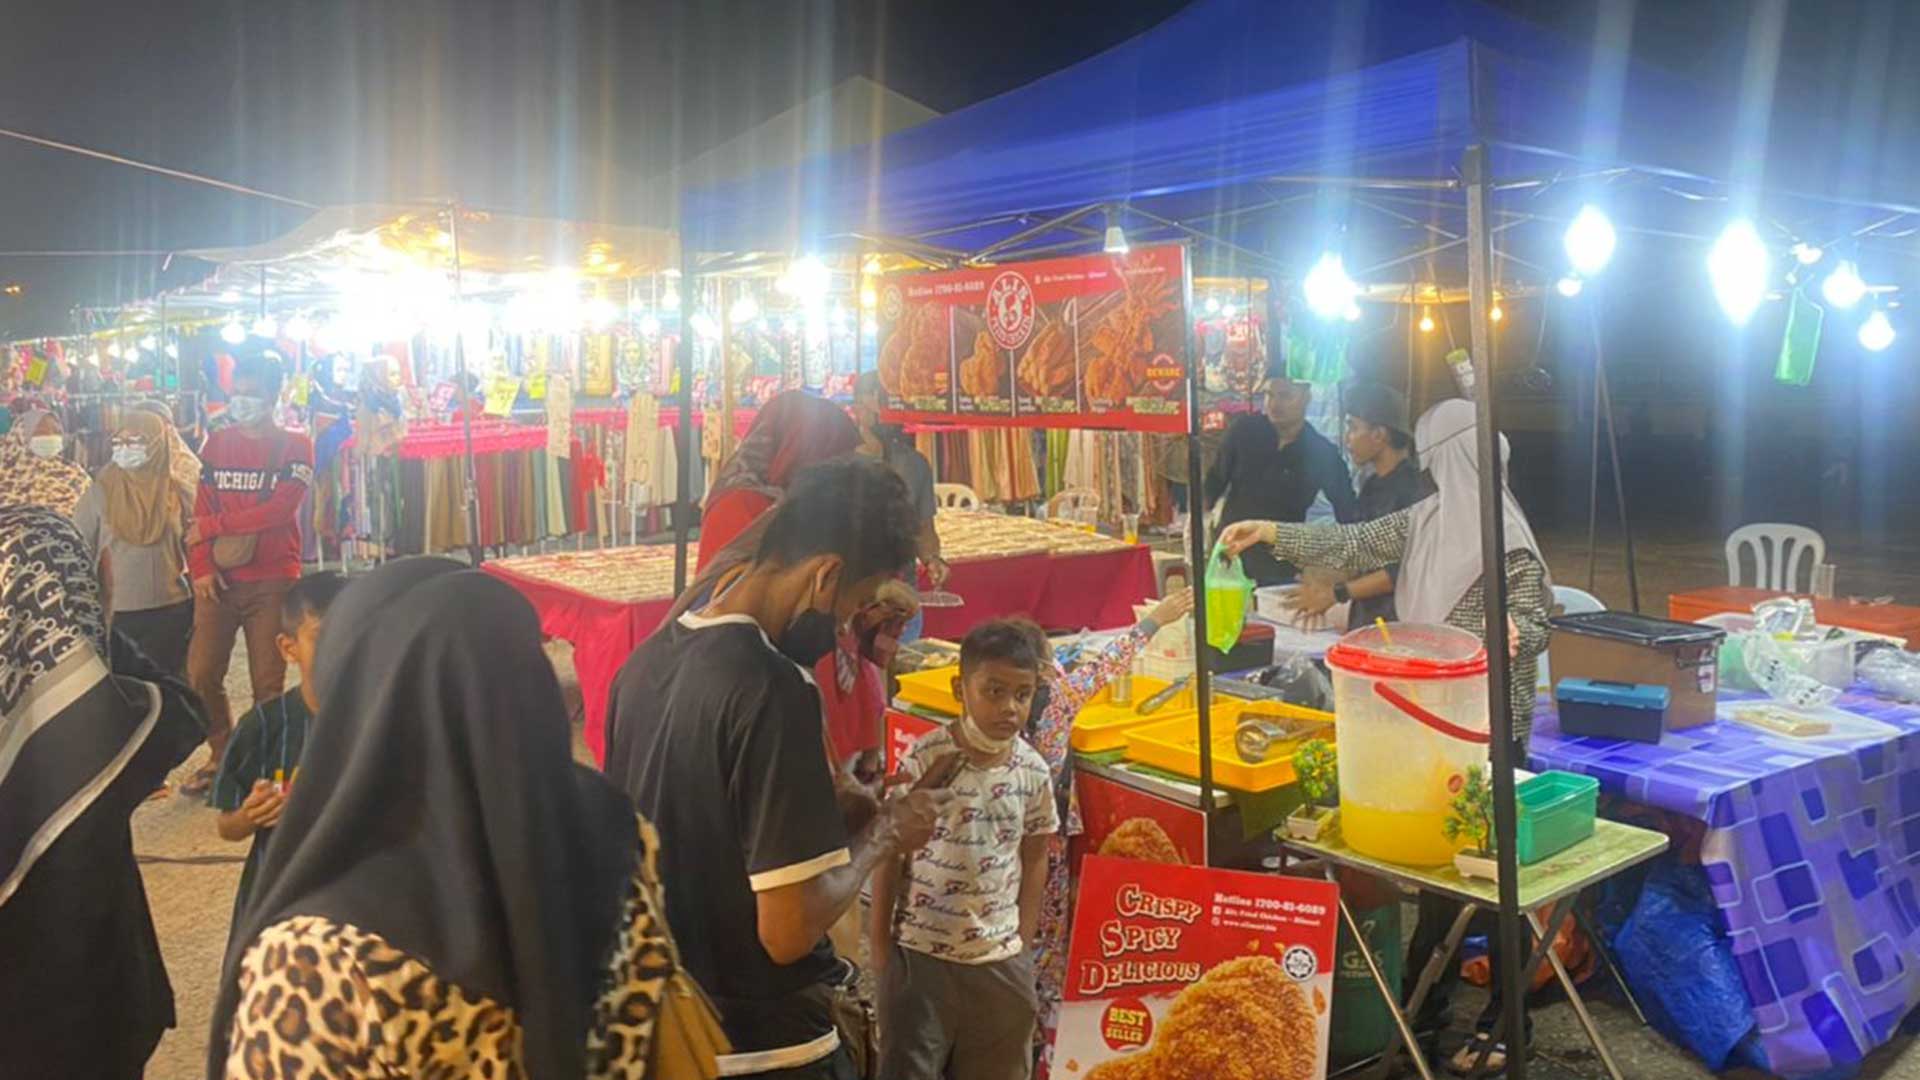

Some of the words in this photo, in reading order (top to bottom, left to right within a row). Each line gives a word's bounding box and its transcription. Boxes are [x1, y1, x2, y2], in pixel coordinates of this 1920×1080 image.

[214, 469, 279, 490] ICHIG
[1117, 884, 1202, 923] CRISPY
[1214, 892, 1253, 907] Hotline
[1100, 920, 1181, 956] SPICY
[1343, 949, 1385, 970] GS
[1079, 960, 1200, 994] DELICIOUS
[1109, 1007, 1147, 1027] BEST
[1105, 1027, 1143, 1043] SELLER
